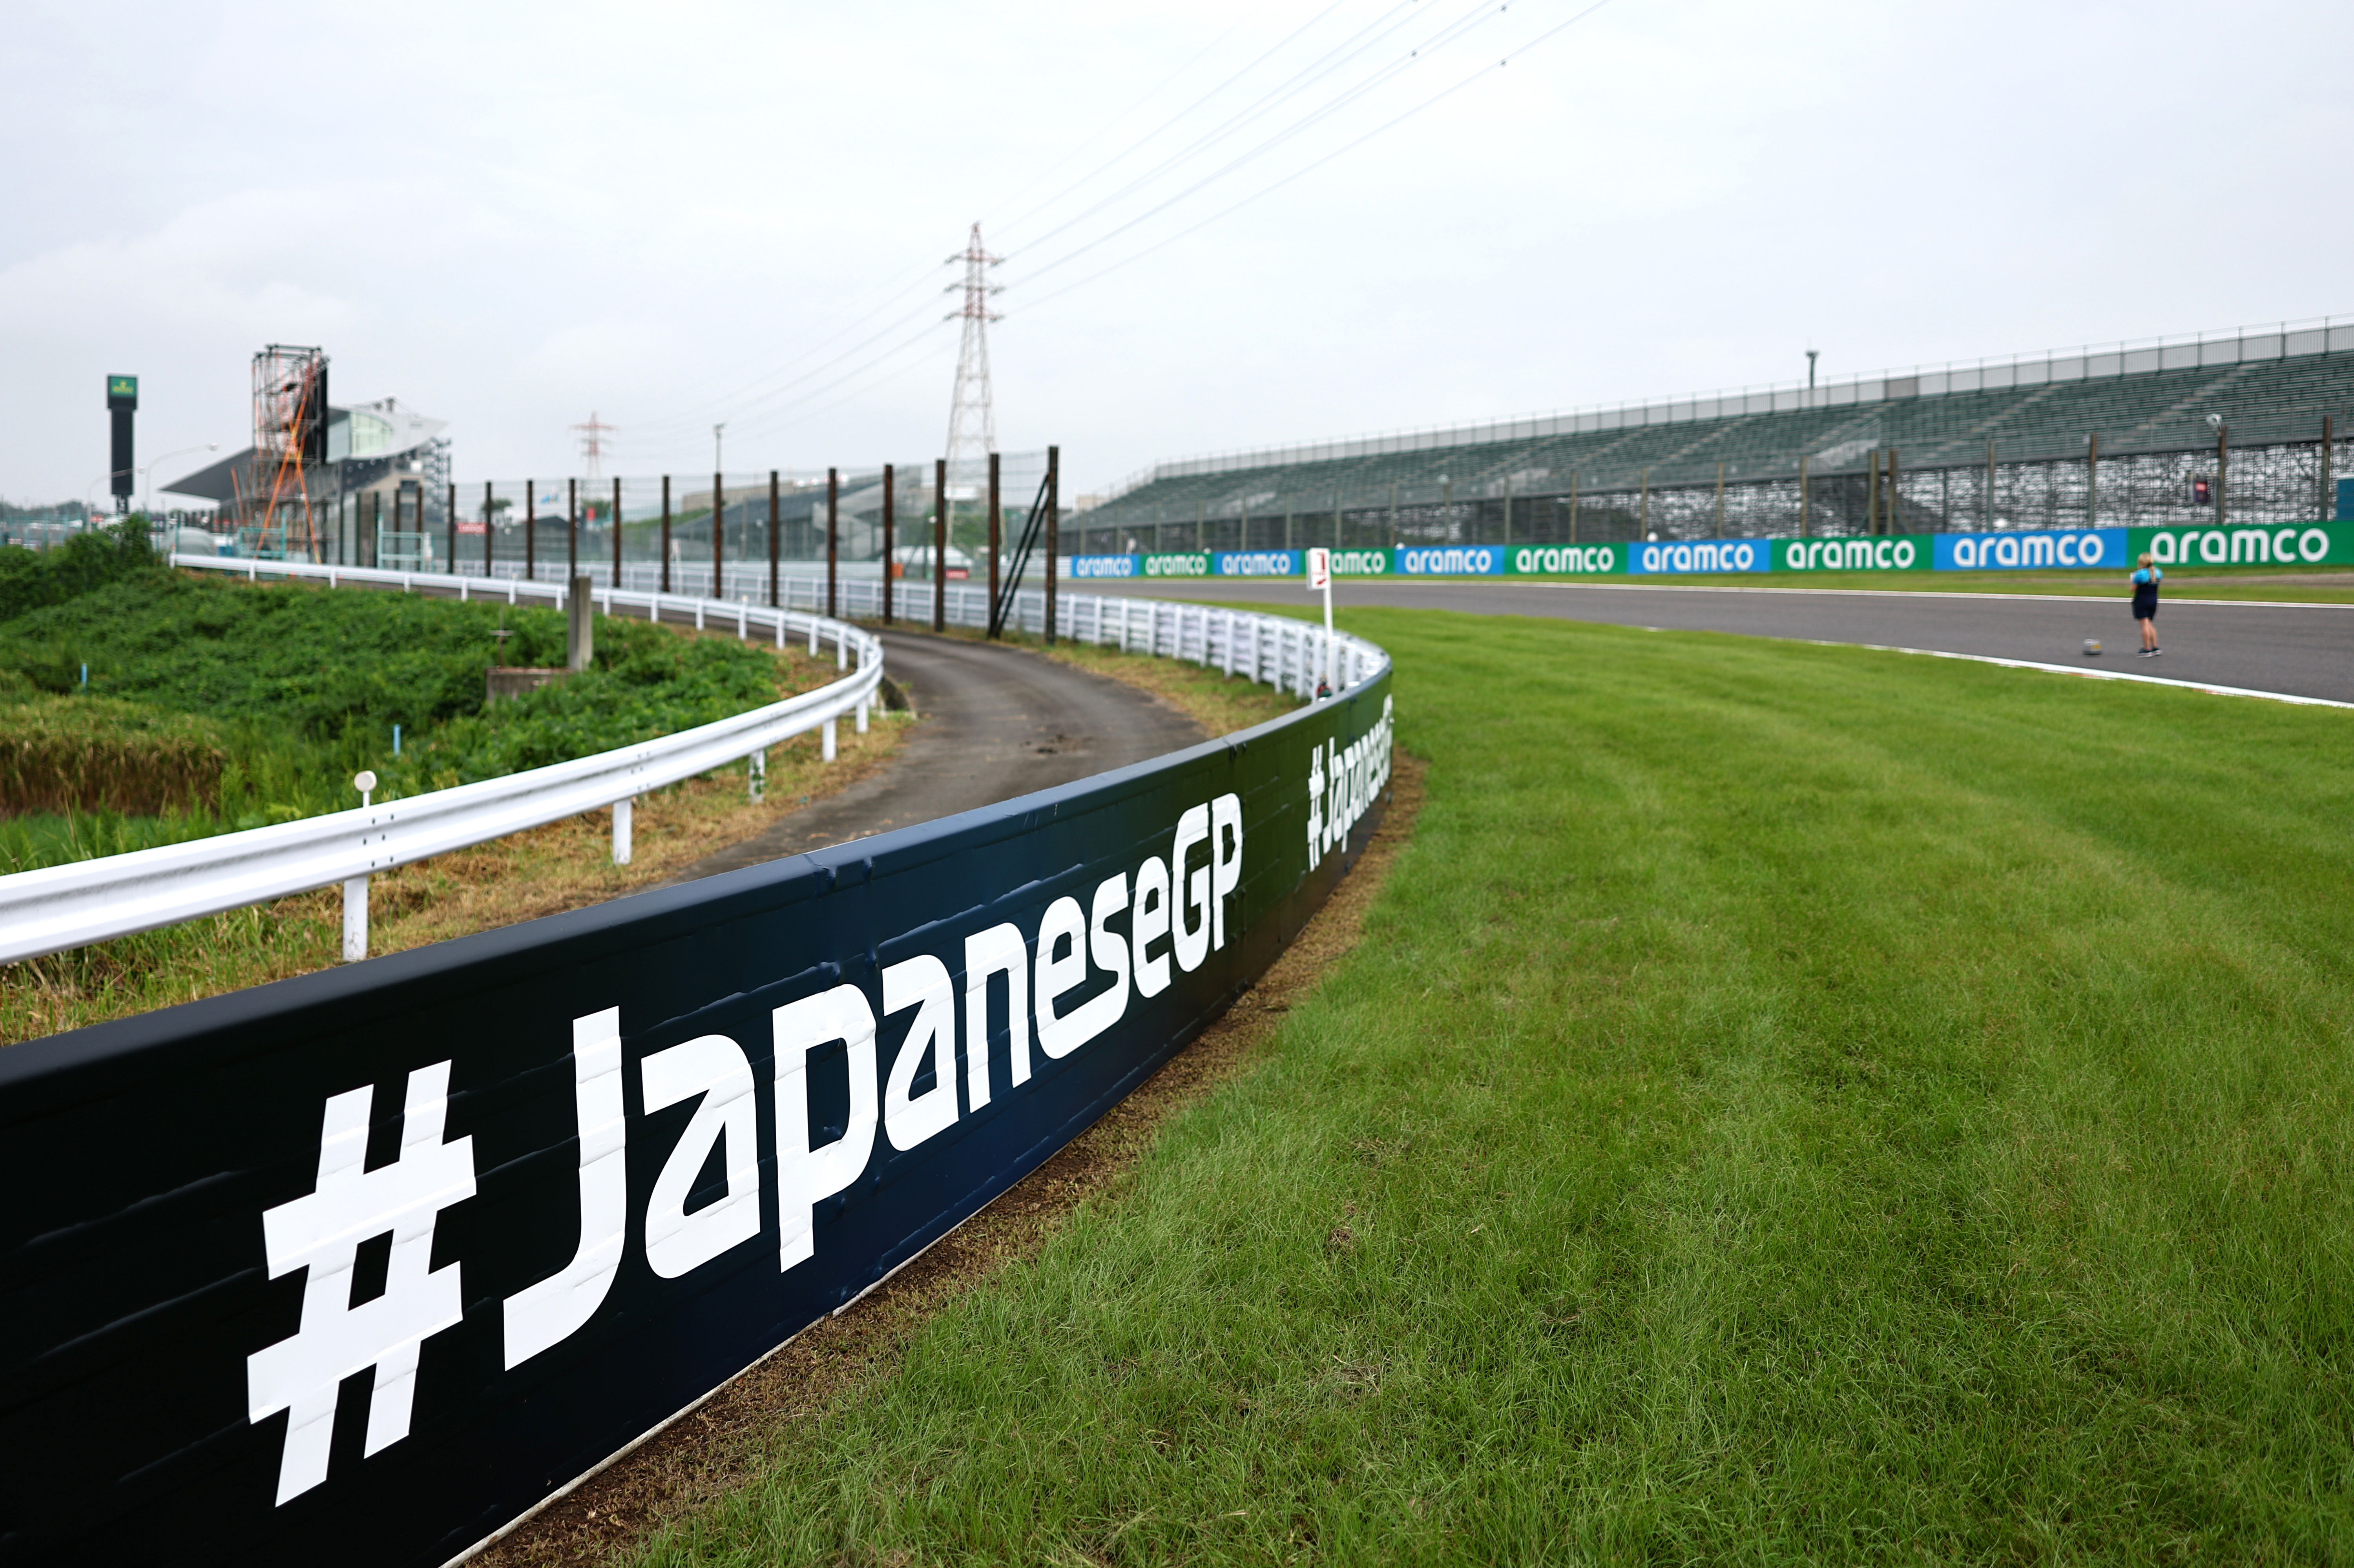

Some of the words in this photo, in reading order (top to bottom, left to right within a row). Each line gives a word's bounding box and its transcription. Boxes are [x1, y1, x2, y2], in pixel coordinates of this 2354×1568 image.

[1642, 543, 1754, 571] aramco
[1786, 540, 1916, 569] aramco
[1953, 534, 2104, 567] aramco
[2150, 528, 2329, 563] aramco
[1077, 557, 1133, 577] aramco
[1146, 555, 1207, 576] aramco
[1222, 553, 1291, 575] aramco
[1331, 551, 1386, 574] amco
[1405, 549, 1492, 573] aramco
[1516, 547, 1614, 573] aramco
[247, 792, 1243, 1508] #JapaneseGP
